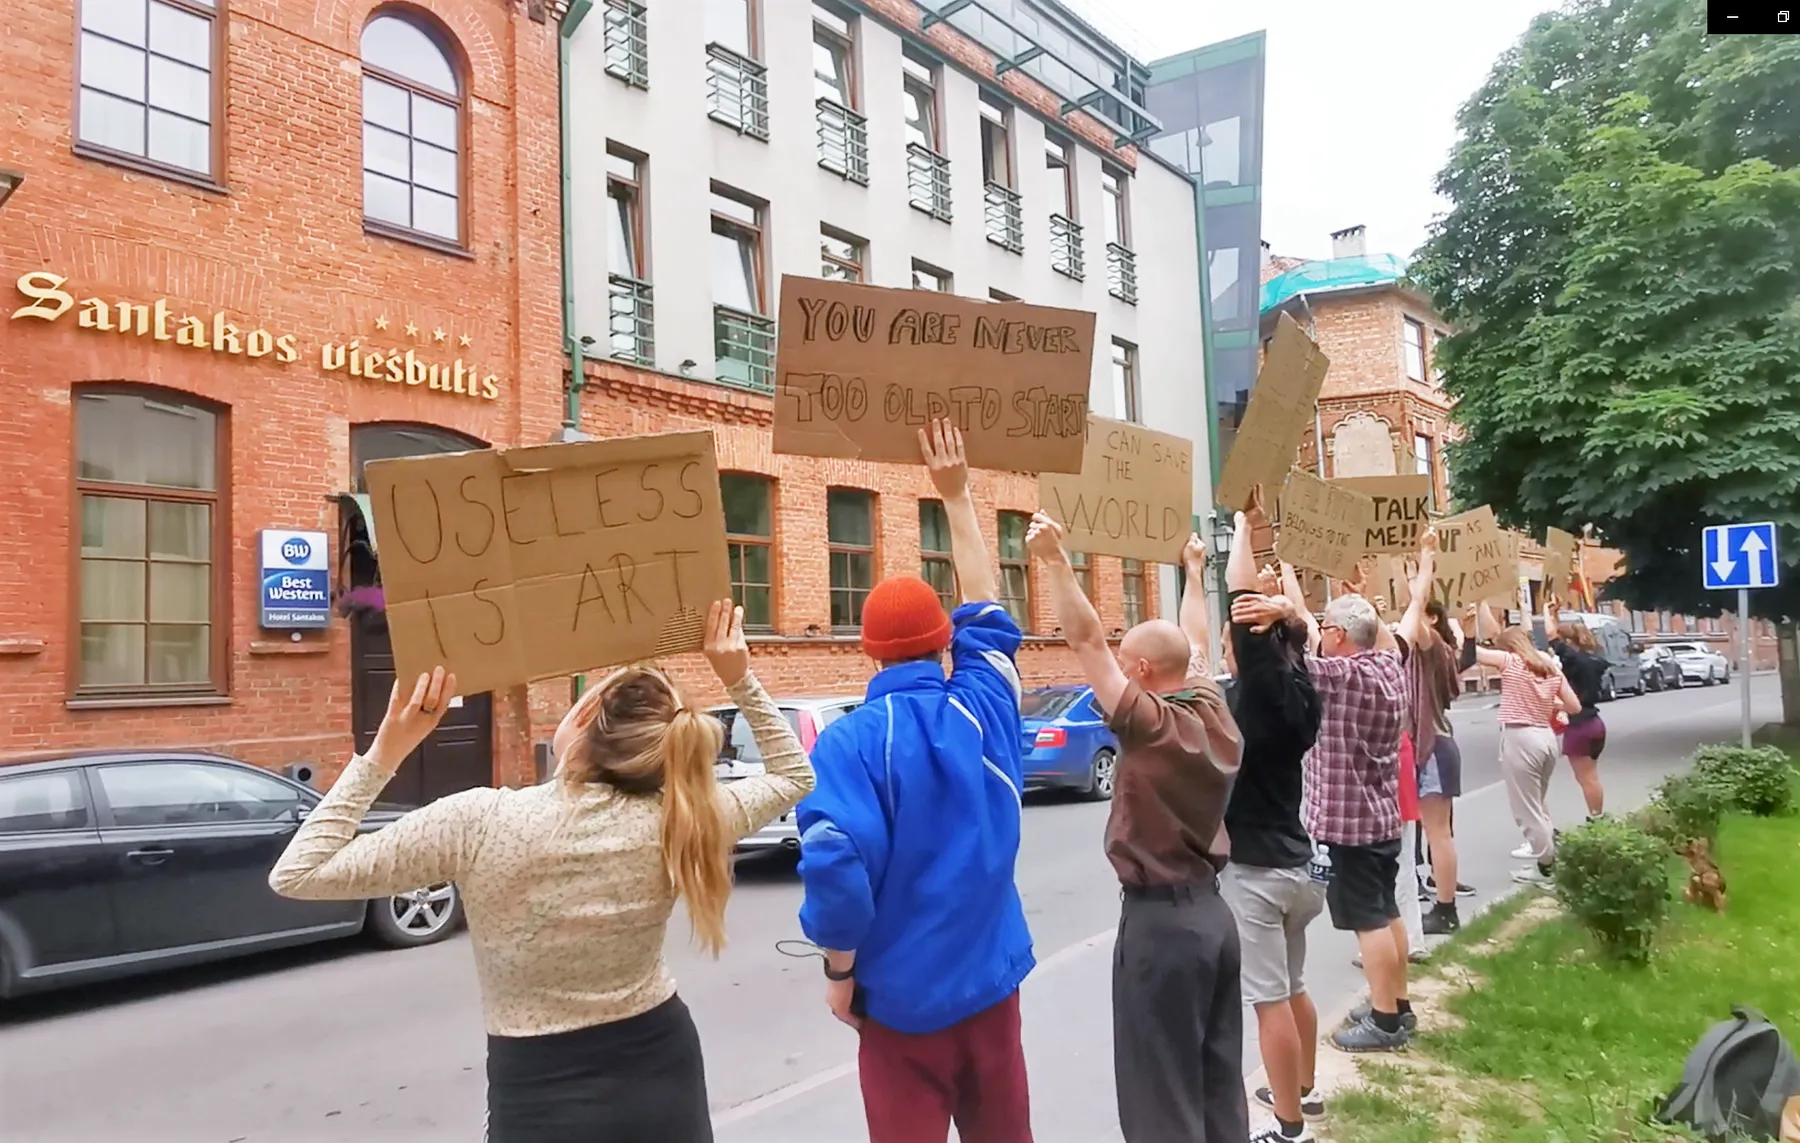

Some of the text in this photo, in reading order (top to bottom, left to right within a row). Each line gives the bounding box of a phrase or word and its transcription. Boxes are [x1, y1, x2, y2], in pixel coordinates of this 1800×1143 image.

[10, 271, 299, 364] Santakos
[797, 297, 1081, 355] YOU ARE NEVER
[784, 372, 869, 423] TOO
[884, 382, 950, 426] OLD
[950, 385, 1002, 432] TO
[1006, 385, 1087, 438] START
[1102, 454, 1134, 483] THE
[1107, 430, 1142, 456] CAN
[1152, 442, 1189, 474] SAVE
[390, 460, 704, 564] USELESS
[1053, 486, 1181, 542] WORLD
[1371, 496, 1429, 522] TALK
[283, 543, 309, 558] BW
[1365, 523, 1418, 548] ME!!
[281, 575, 312, 589] Best
[425, 548, 700, 659] IS ART
